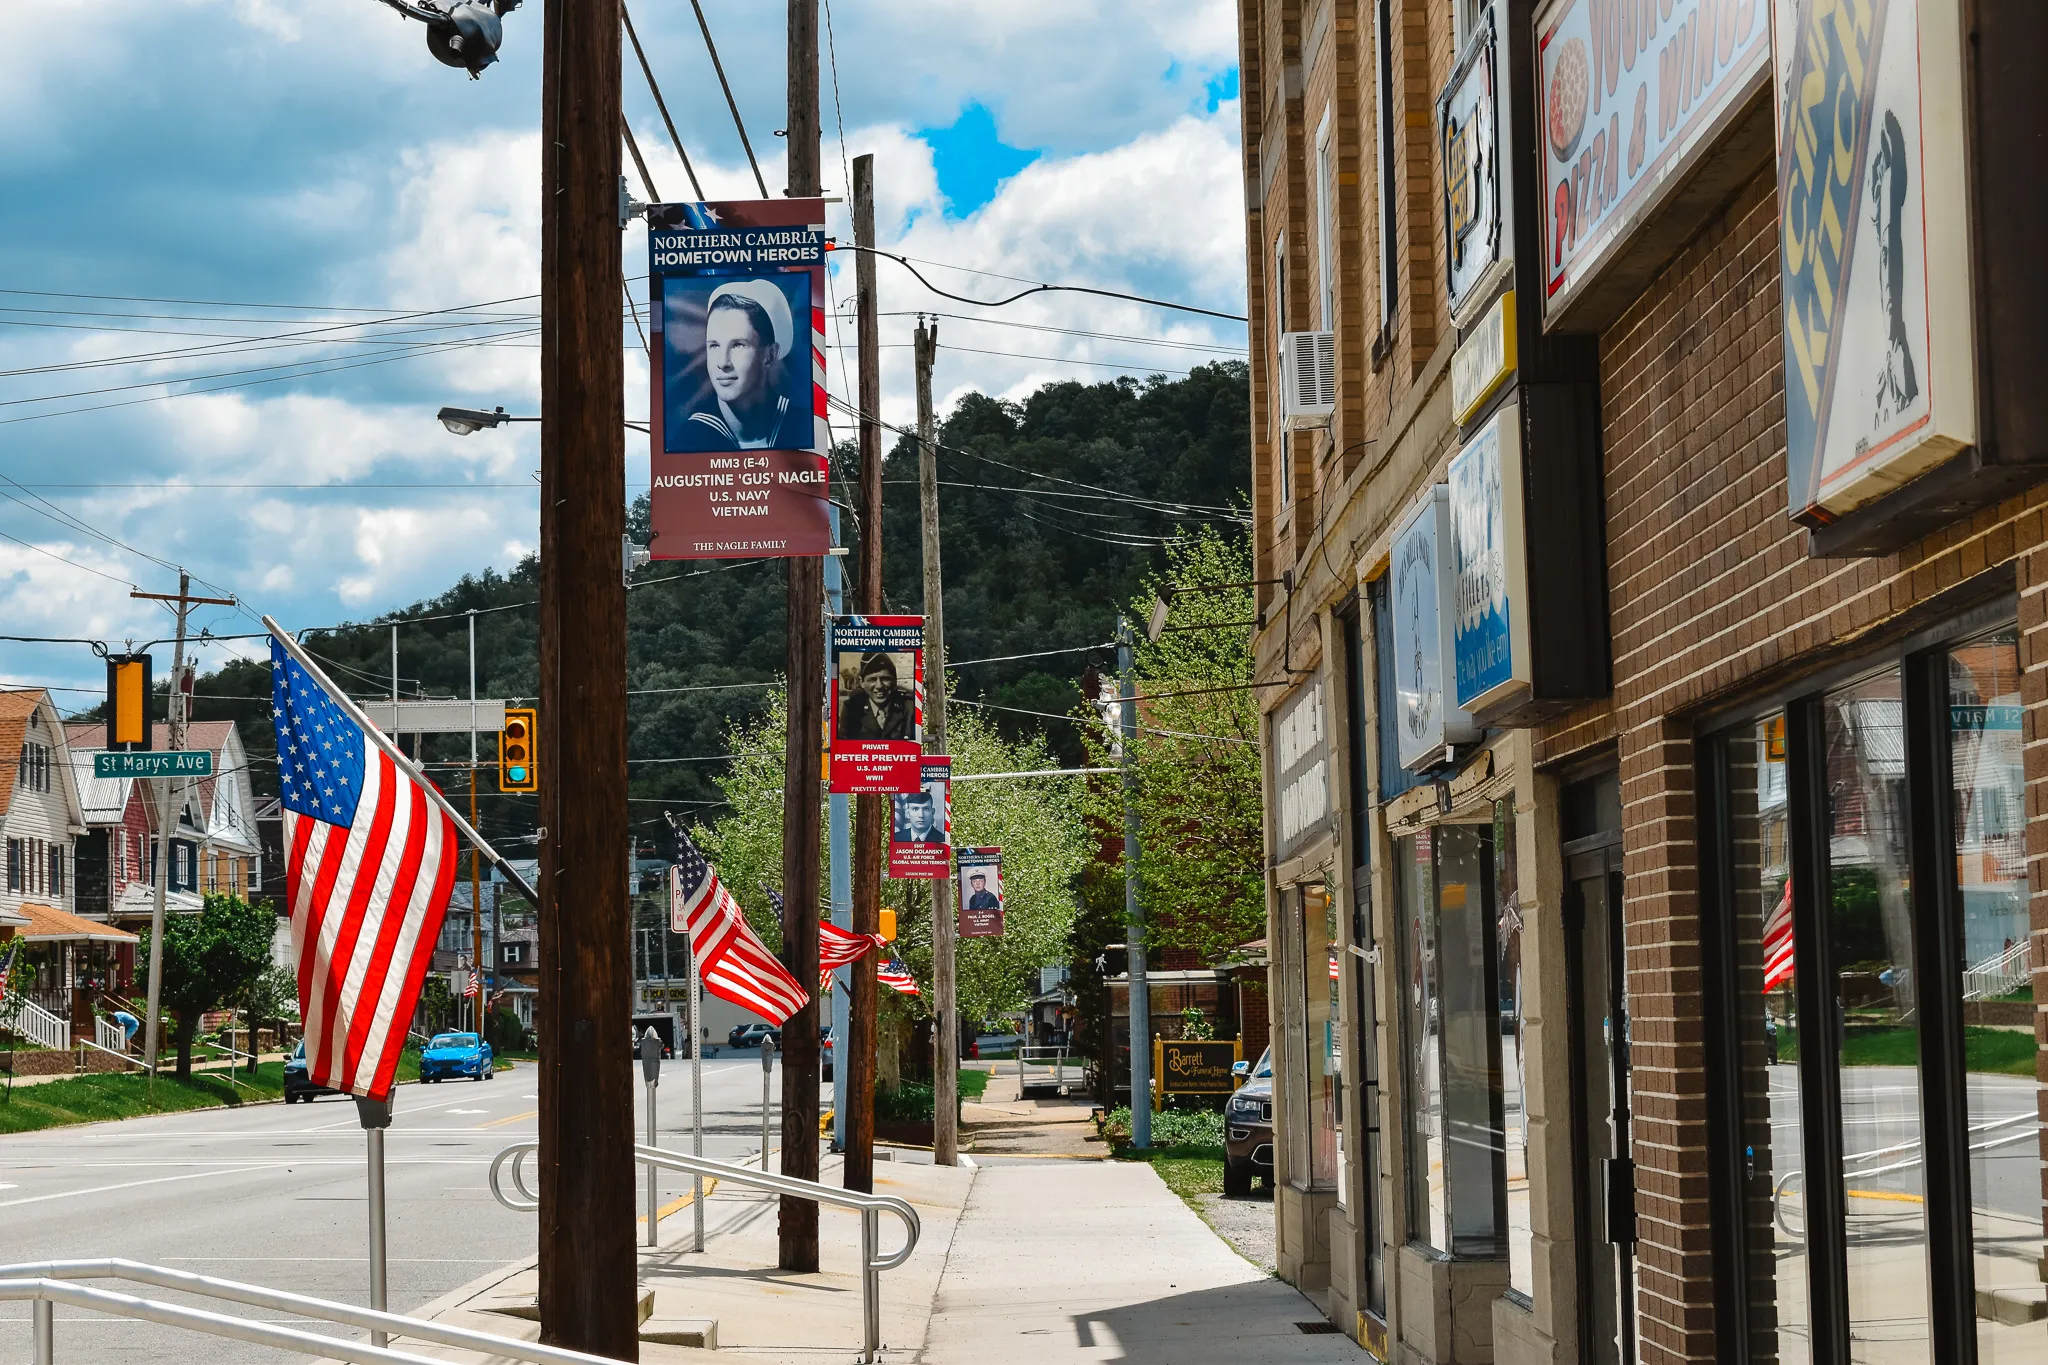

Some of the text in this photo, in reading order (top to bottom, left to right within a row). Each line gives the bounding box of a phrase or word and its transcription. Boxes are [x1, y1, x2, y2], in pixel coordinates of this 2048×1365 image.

[1554, 111, 1619, 268] PIZZA
[1627, 81, 1648, 179] &
[654, 231, 819, 250] NORTHERN CAMBRIA
[654, 247, 819, 266] HOMETOWN HEROES
[710, 456, 769, 469] MM3 (E-4)
[654, 470, 826, 488] AUGUSTINE 'GUS' NAGLE
[709, 490, 771, 502] U.S. NAVY
[711, 505, 769, 517] VIETNAM
[693, 540, 787, 551] THE NAGLE FAMILY
[834, 628, 920, 637] NORTHERN CAMBRIA
[834, 638, 921, 646] HOMETOWN HEROES
[102, 755, 205, 774] St Marys Ave
[834, 754, 917, 762] PETER PREVITE
[1168, 1048, 1204, 1076] Barrett
